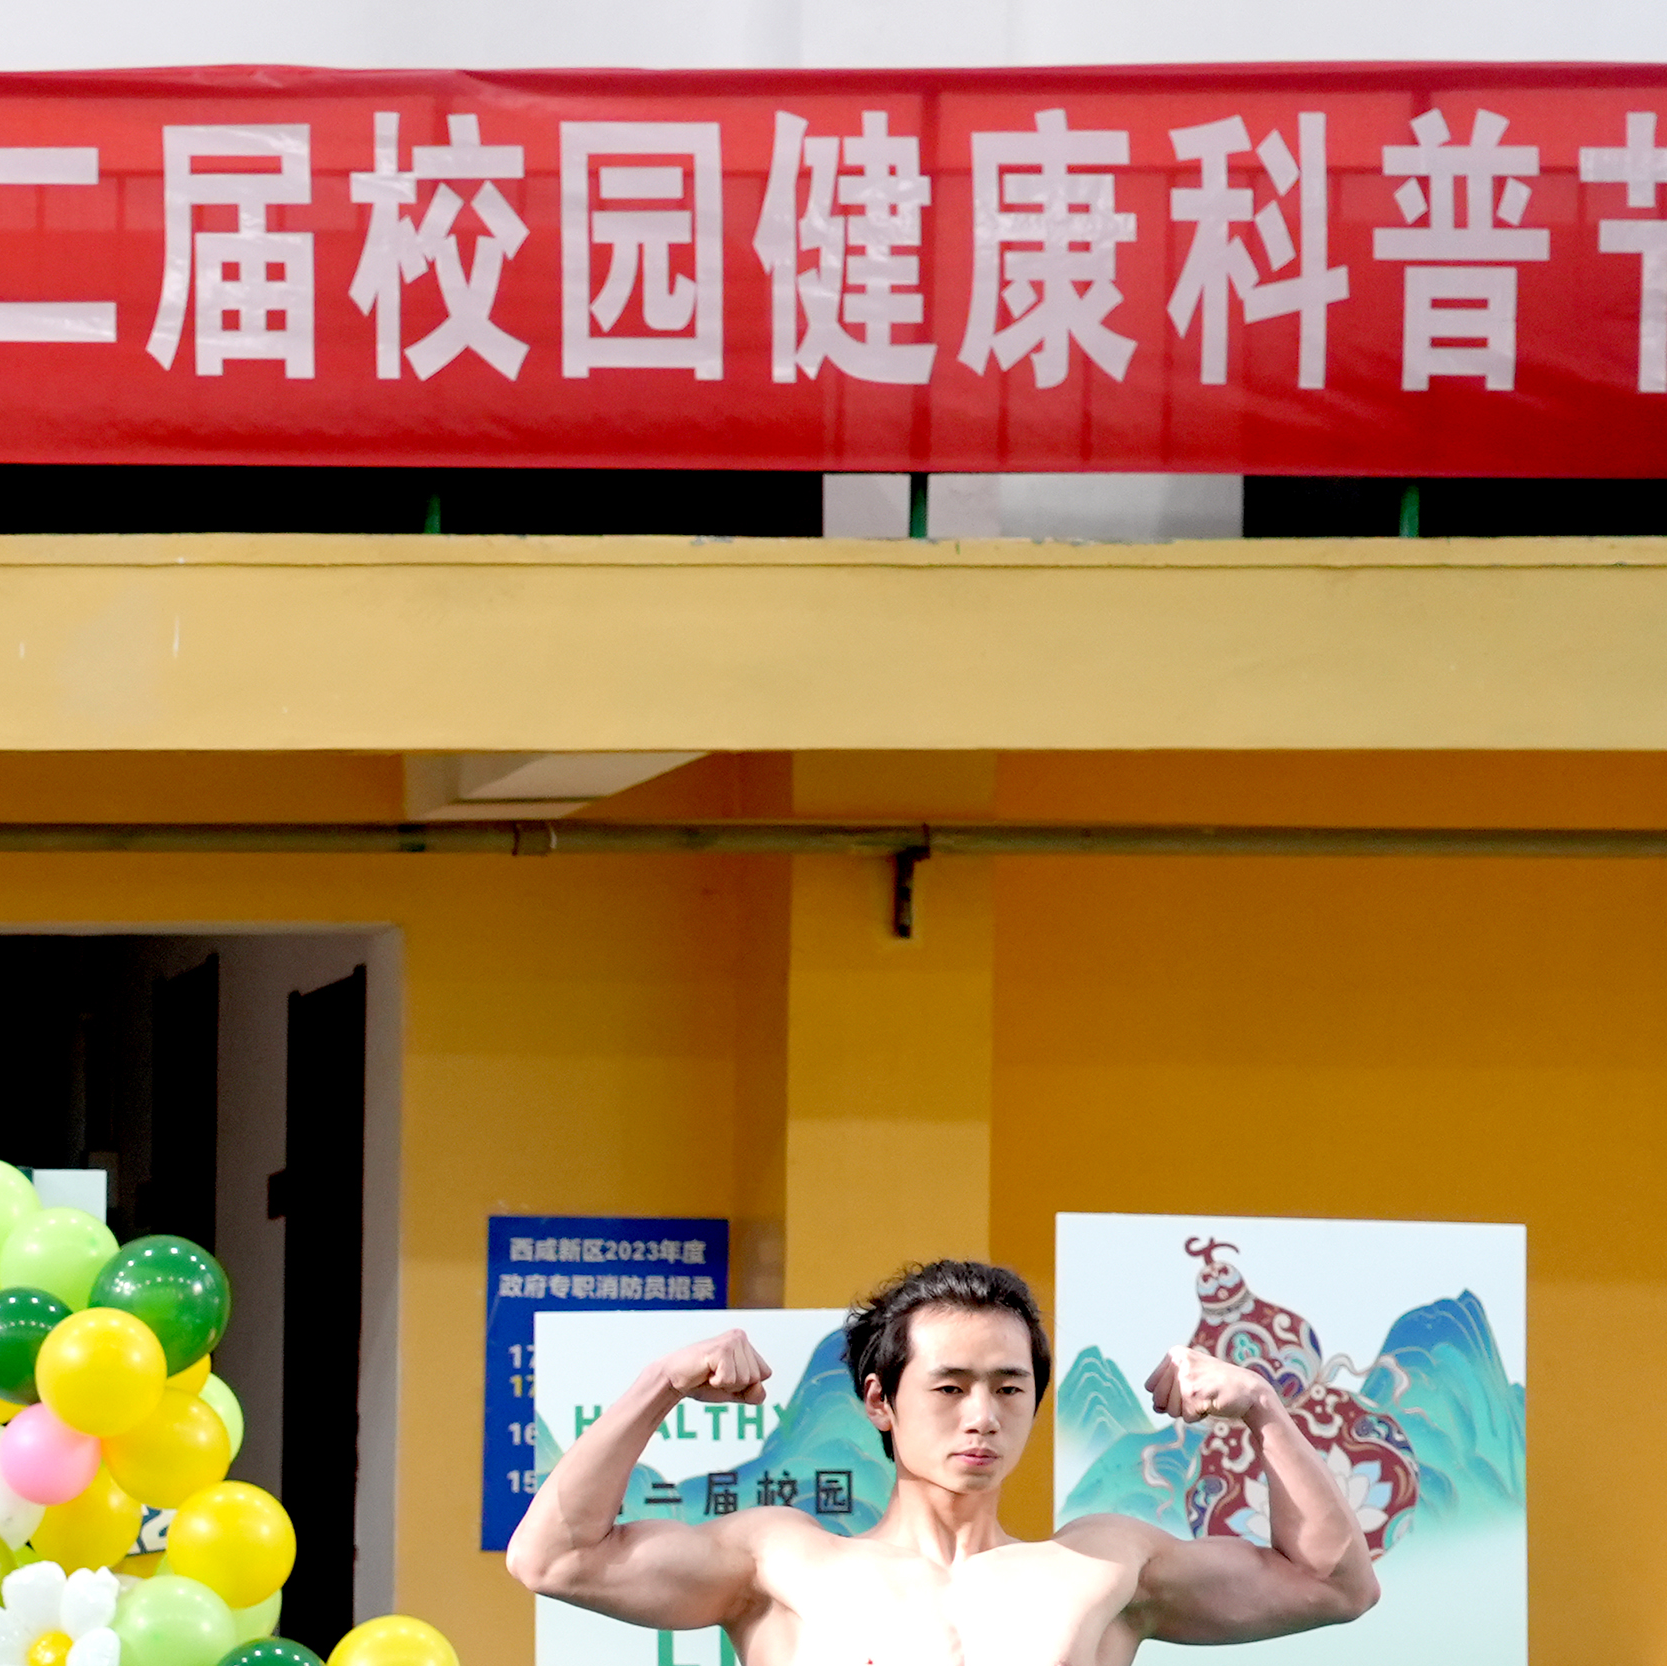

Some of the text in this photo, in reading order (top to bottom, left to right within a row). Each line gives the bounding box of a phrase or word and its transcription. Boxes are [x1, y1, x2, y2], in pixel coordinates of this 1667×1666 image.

[499, 1273, 715, 1301] 政府专职消防员招录
